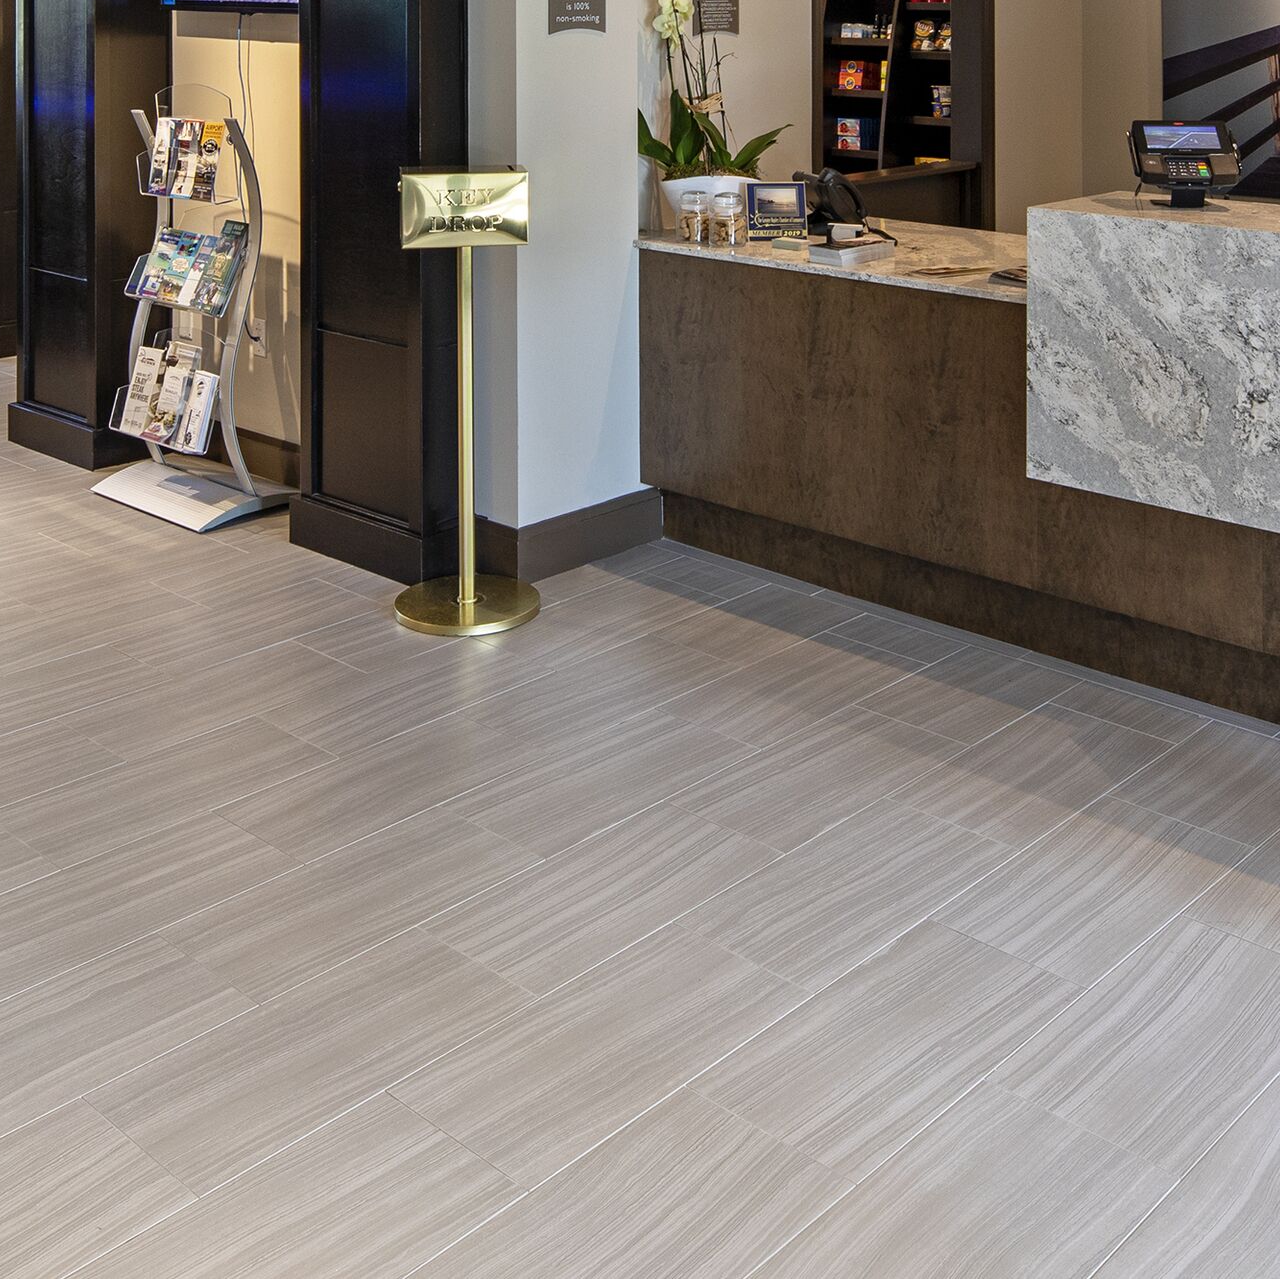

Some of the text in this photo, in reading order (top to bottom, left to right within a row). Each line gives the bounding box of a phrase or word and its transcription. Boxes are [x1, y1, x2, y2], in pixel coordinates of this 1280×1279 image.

[566, 2, 590, 11] is 100%
[556, 14, 600, 24] non-smoking
[436, 188, 496, 208] KEY
[428, 215, 504, 233] DROP
